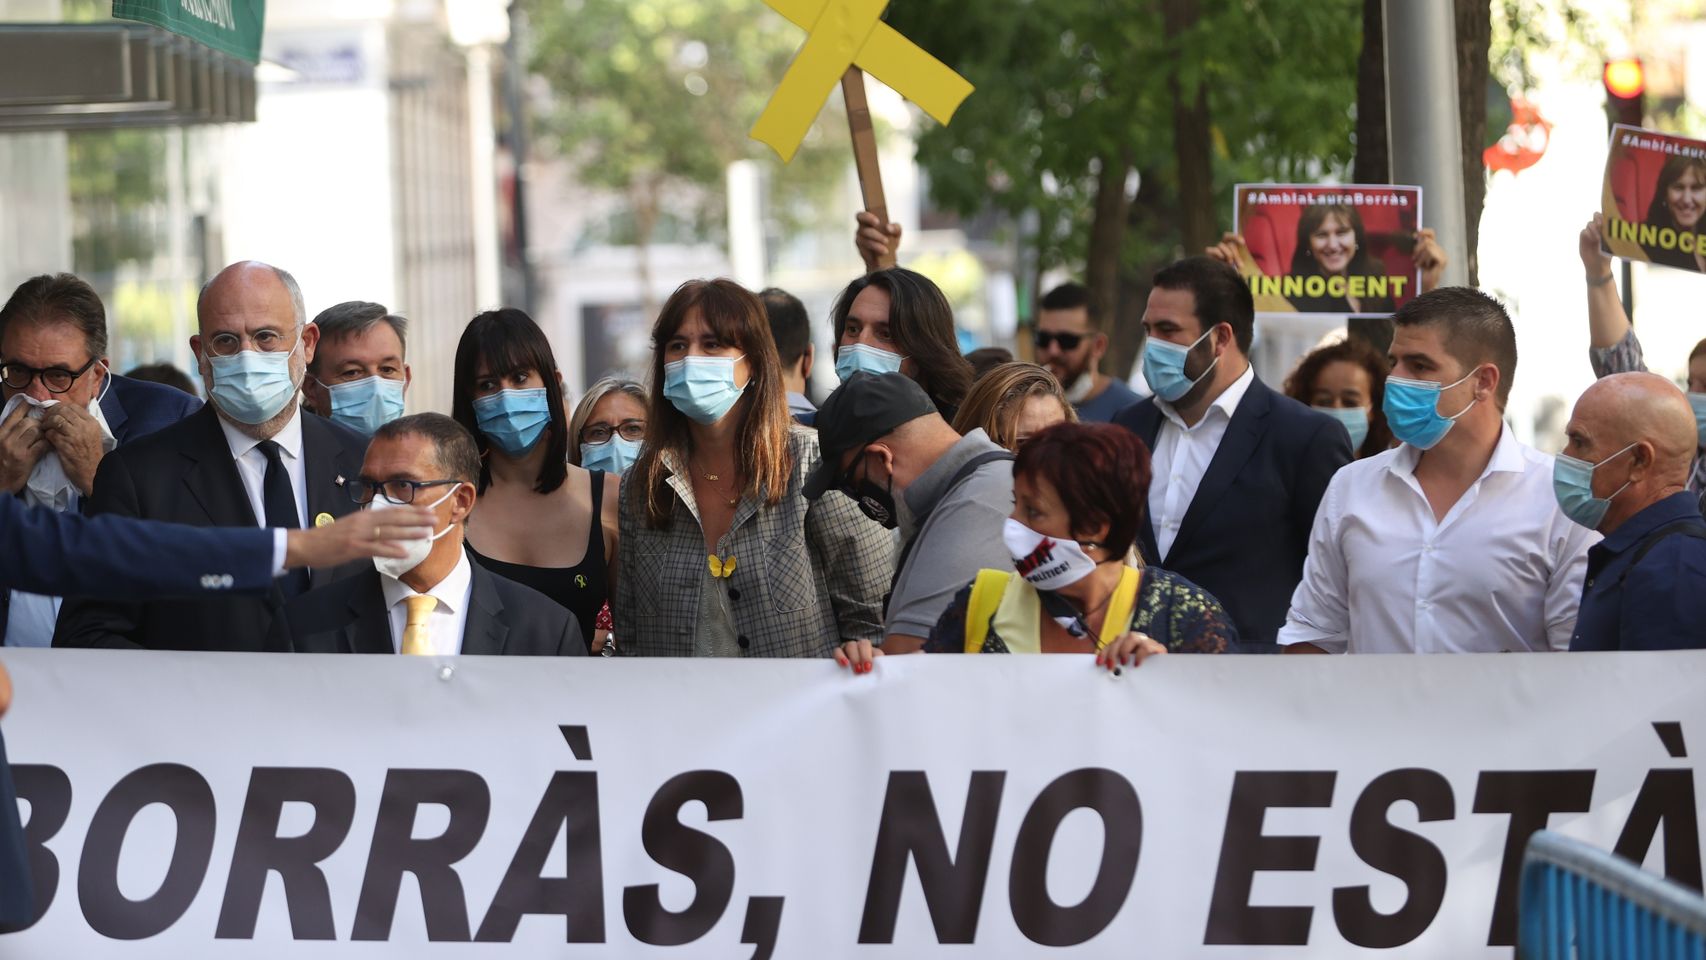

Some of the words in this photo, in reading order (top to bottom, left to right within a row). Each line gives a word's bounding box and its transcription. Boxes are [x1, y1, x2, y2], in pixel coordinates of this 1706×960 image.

[1250, 273, 1409, 298] INNOCENT
[0, 724, 786, 960] BORRÀS,
[857, 766, 1143, 948] NO
[1203, 721, 1704, 949] ESTÀ
